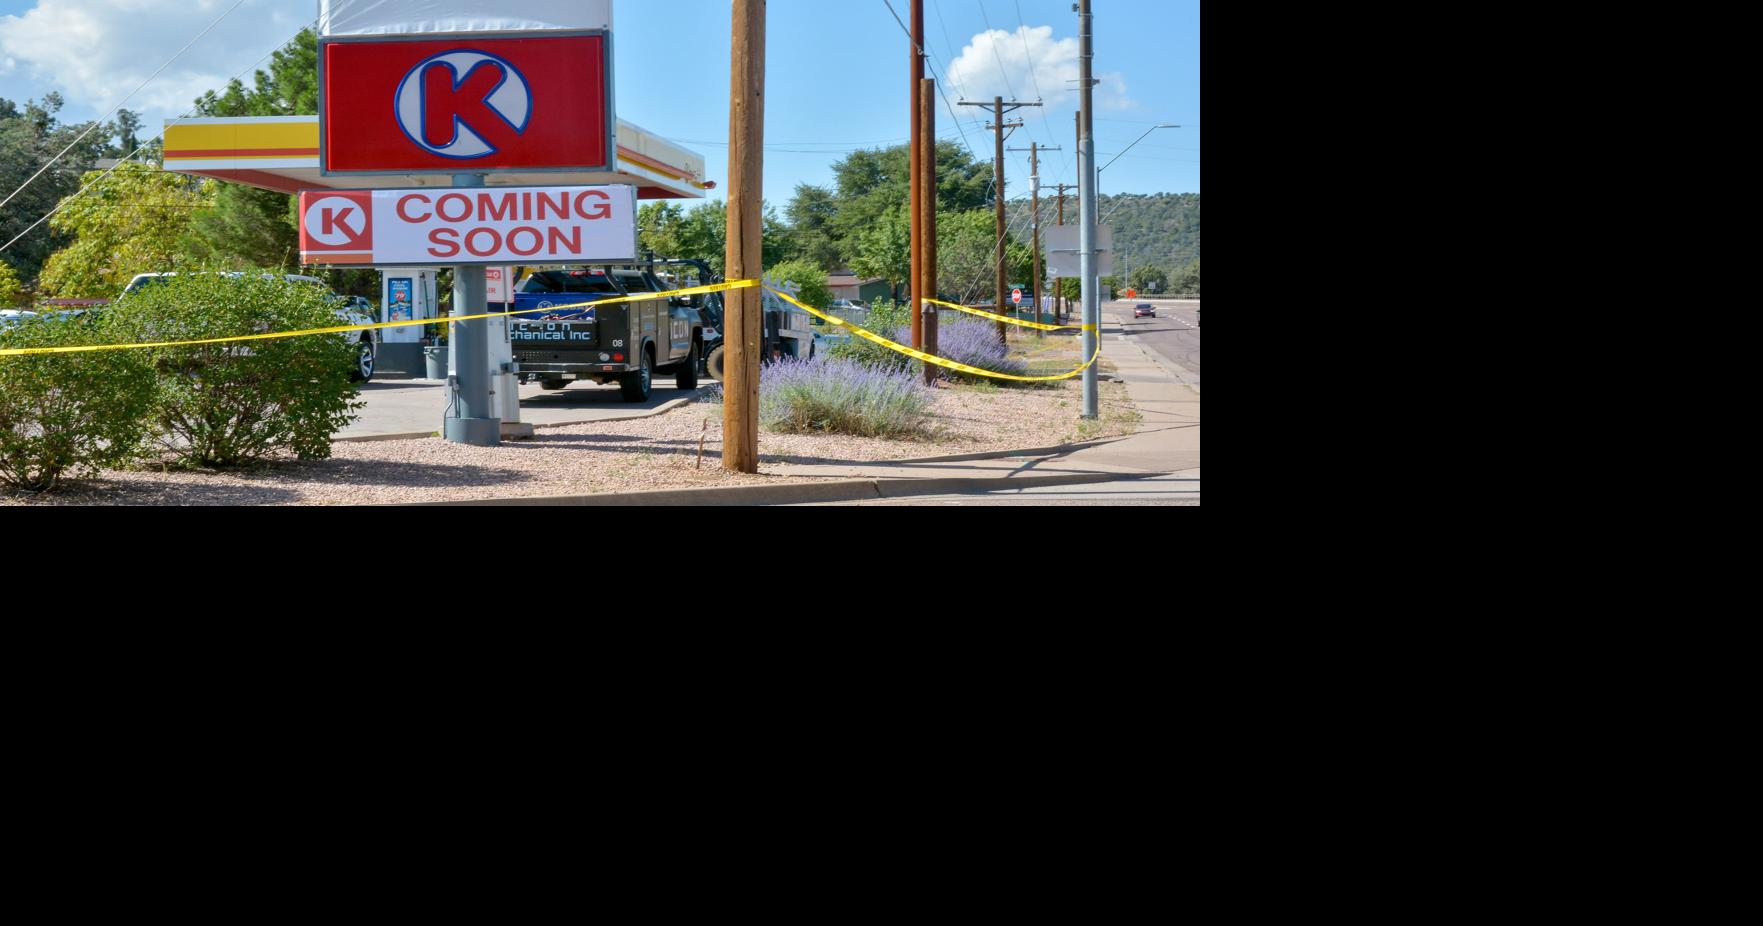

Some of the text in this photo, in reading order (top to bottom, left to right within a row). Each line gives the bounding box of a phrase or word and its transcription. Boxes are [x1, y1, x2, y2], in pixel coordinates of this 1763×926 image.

[396, 190, 611, 223] COMING
[322, 207, 359, 242] K
[427, 226, 581, 257] SOON
[510, 330, 591, 340] chanical Inc
[670, 319, 689, 339] ICON
[612, 339, 624, 347] 08
